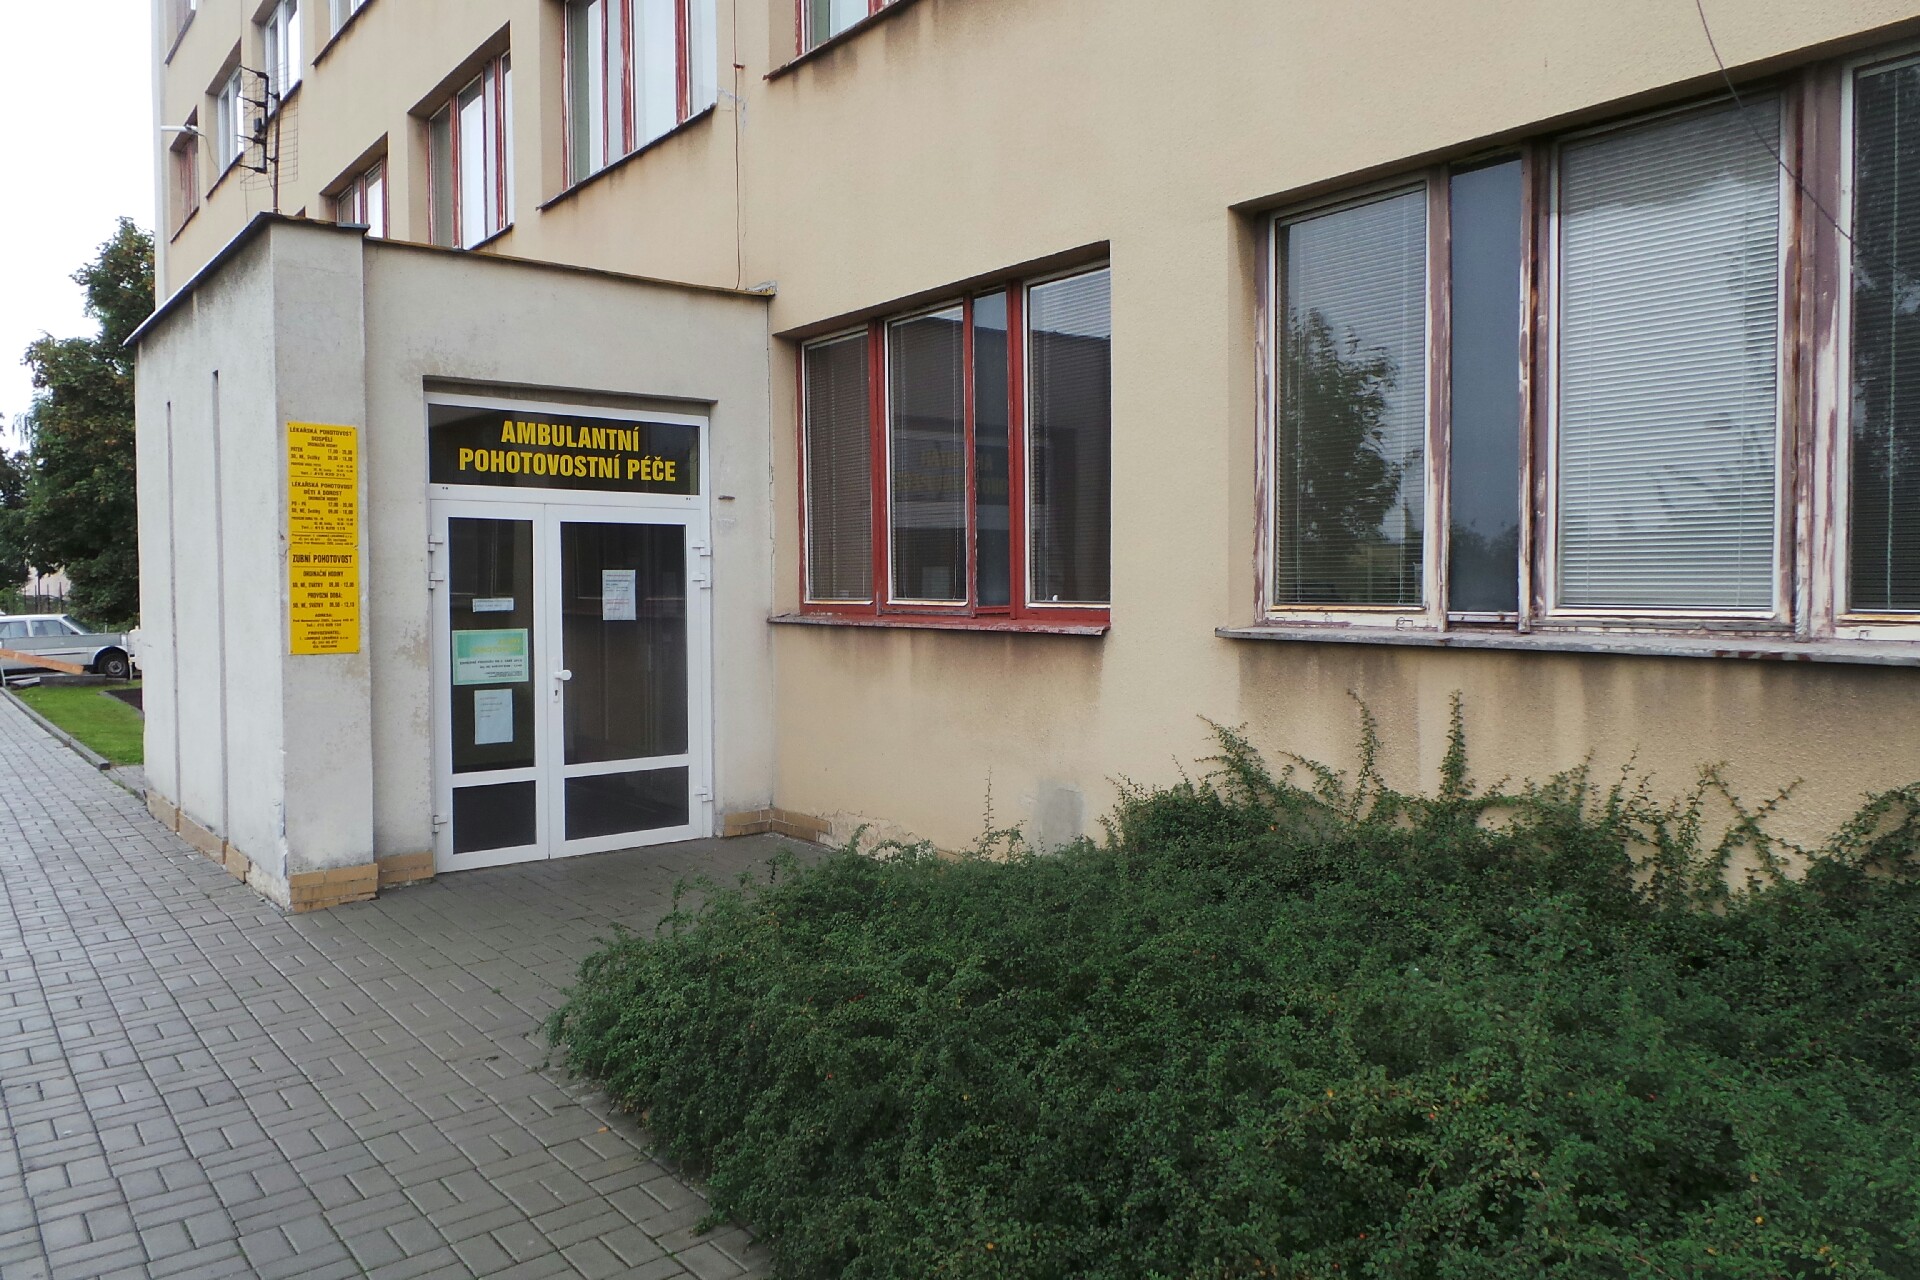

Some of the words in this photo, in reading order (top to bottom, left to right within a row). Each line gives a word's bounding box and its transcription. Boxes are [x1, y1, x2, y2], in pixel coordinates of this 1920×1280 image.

[501, 420, 639, 452] AMBULANTNÍ
[459, 447, 620, 479] POHOTOVOSTNÍ
[627, 456, 676, 482] PÉČE
[293, 552, 311, 563] ZUBNÍ
[314, 555, 352, 563] POHOTOVOST
